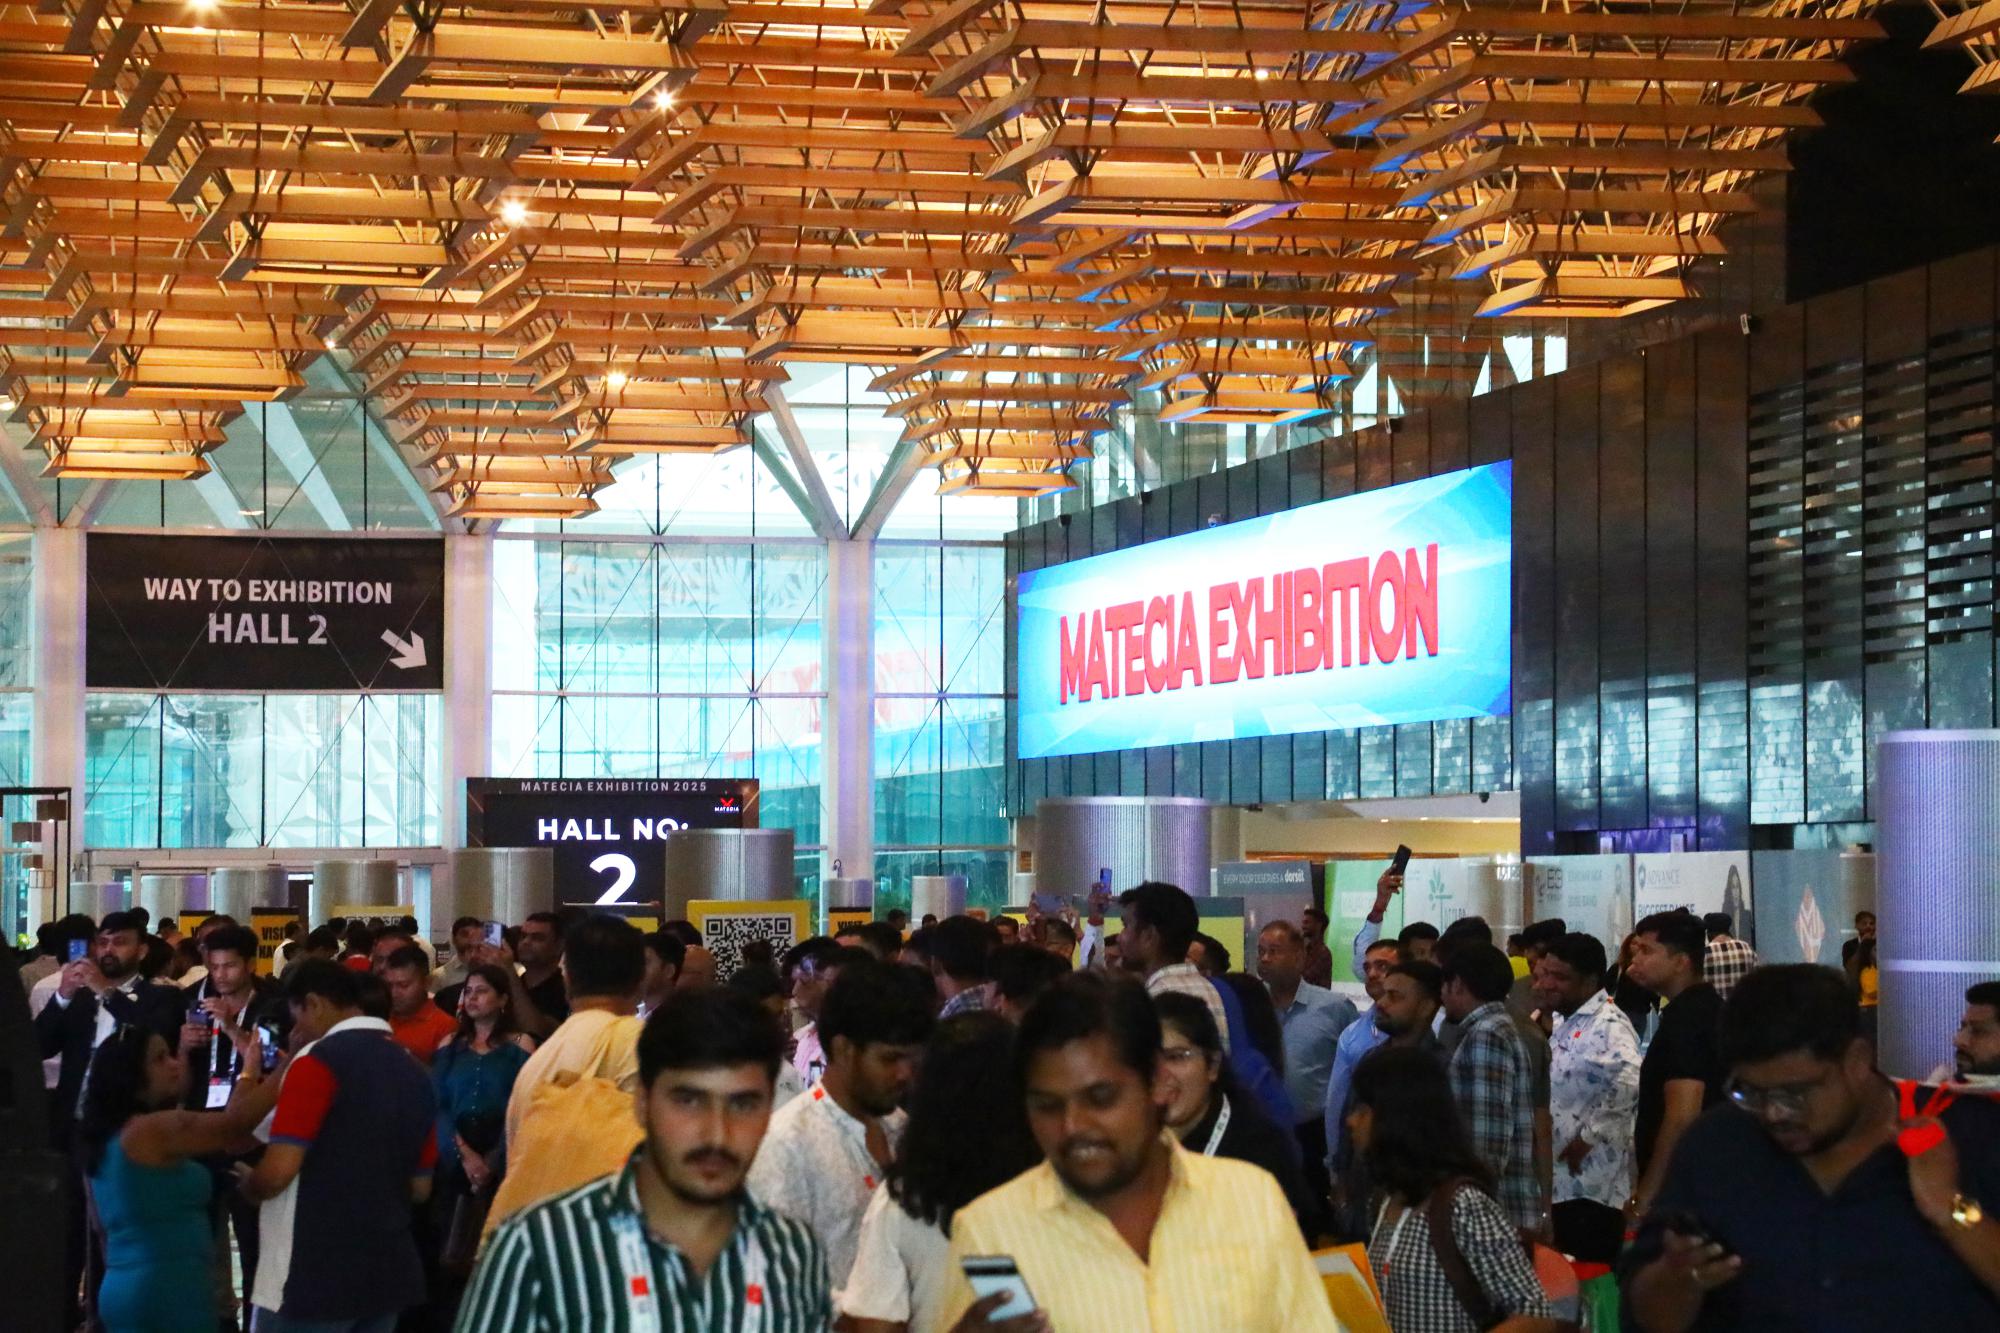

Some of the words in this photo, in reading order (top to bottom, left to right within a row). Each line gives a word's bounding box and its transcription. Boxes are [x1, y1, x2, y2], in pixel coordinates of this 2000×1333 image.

[144, 578, 202, 601] WAY
[207, 579, 241, 602] TO
[248, 580, 392, 604] EXHIBITION
[208, 613, 299, 645] HALL
[307, 614, 328, 645] 2
[1060, 591, 1203, 705] MATECIA
[1209, 543, 1439, 684] EXHIBITION
[521, 781, 583, 792] MATECIA
[587, 781, 669, 792] EXHIBITION
[673, 781, 707, 792] 2025
[538, 818, 620, 840] HALL
[589, 853, 638, 905] 2
[262, 927, 285, 940] VISI
